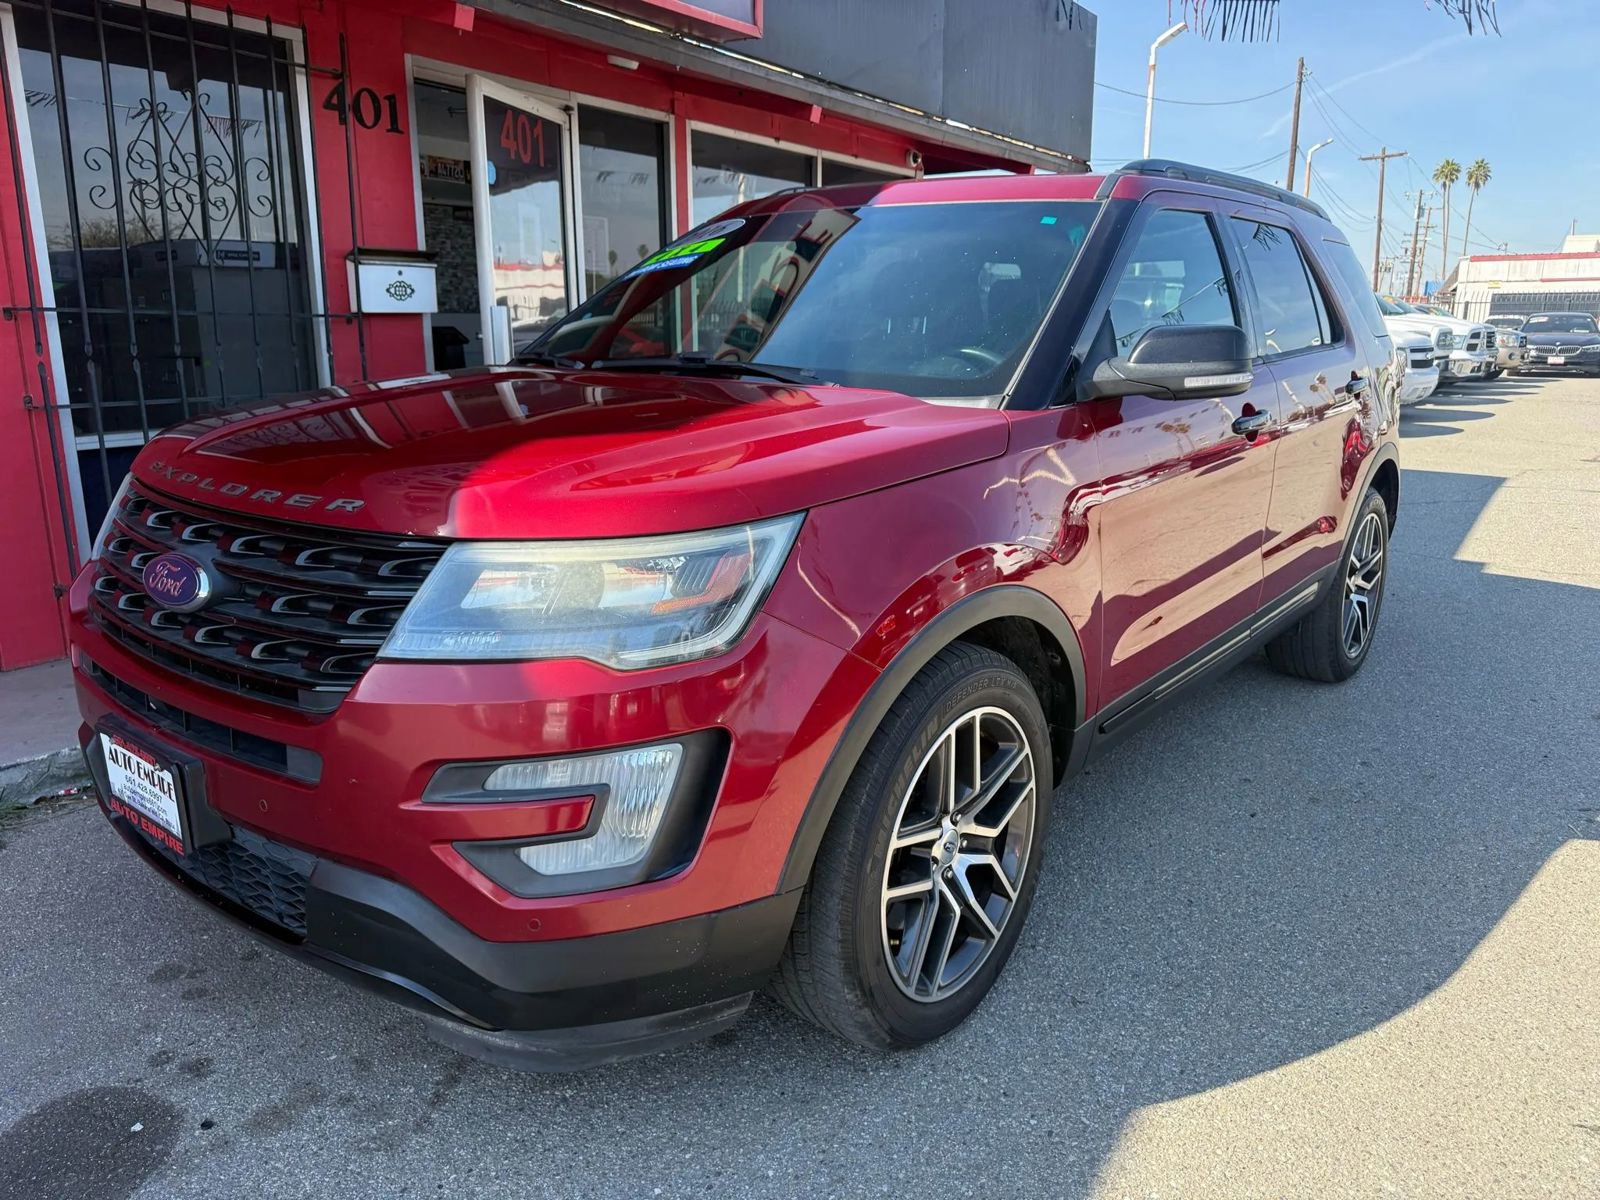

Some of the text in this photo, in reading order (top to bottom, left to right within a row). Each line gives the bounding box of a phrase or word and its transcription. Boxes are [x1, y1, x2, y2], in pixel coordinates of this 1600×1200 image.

[322, 80, 404, 134] 401
[500, 109, 545, 167] 401
[150, 461, 365, 513] EXPLORER
[149, 560, 188, 597] Ford
[108, 745, 136, 775] AUTO
[110, 799, 139, 826] AUTO
[141, 815, 185, 857] EMPIRE
